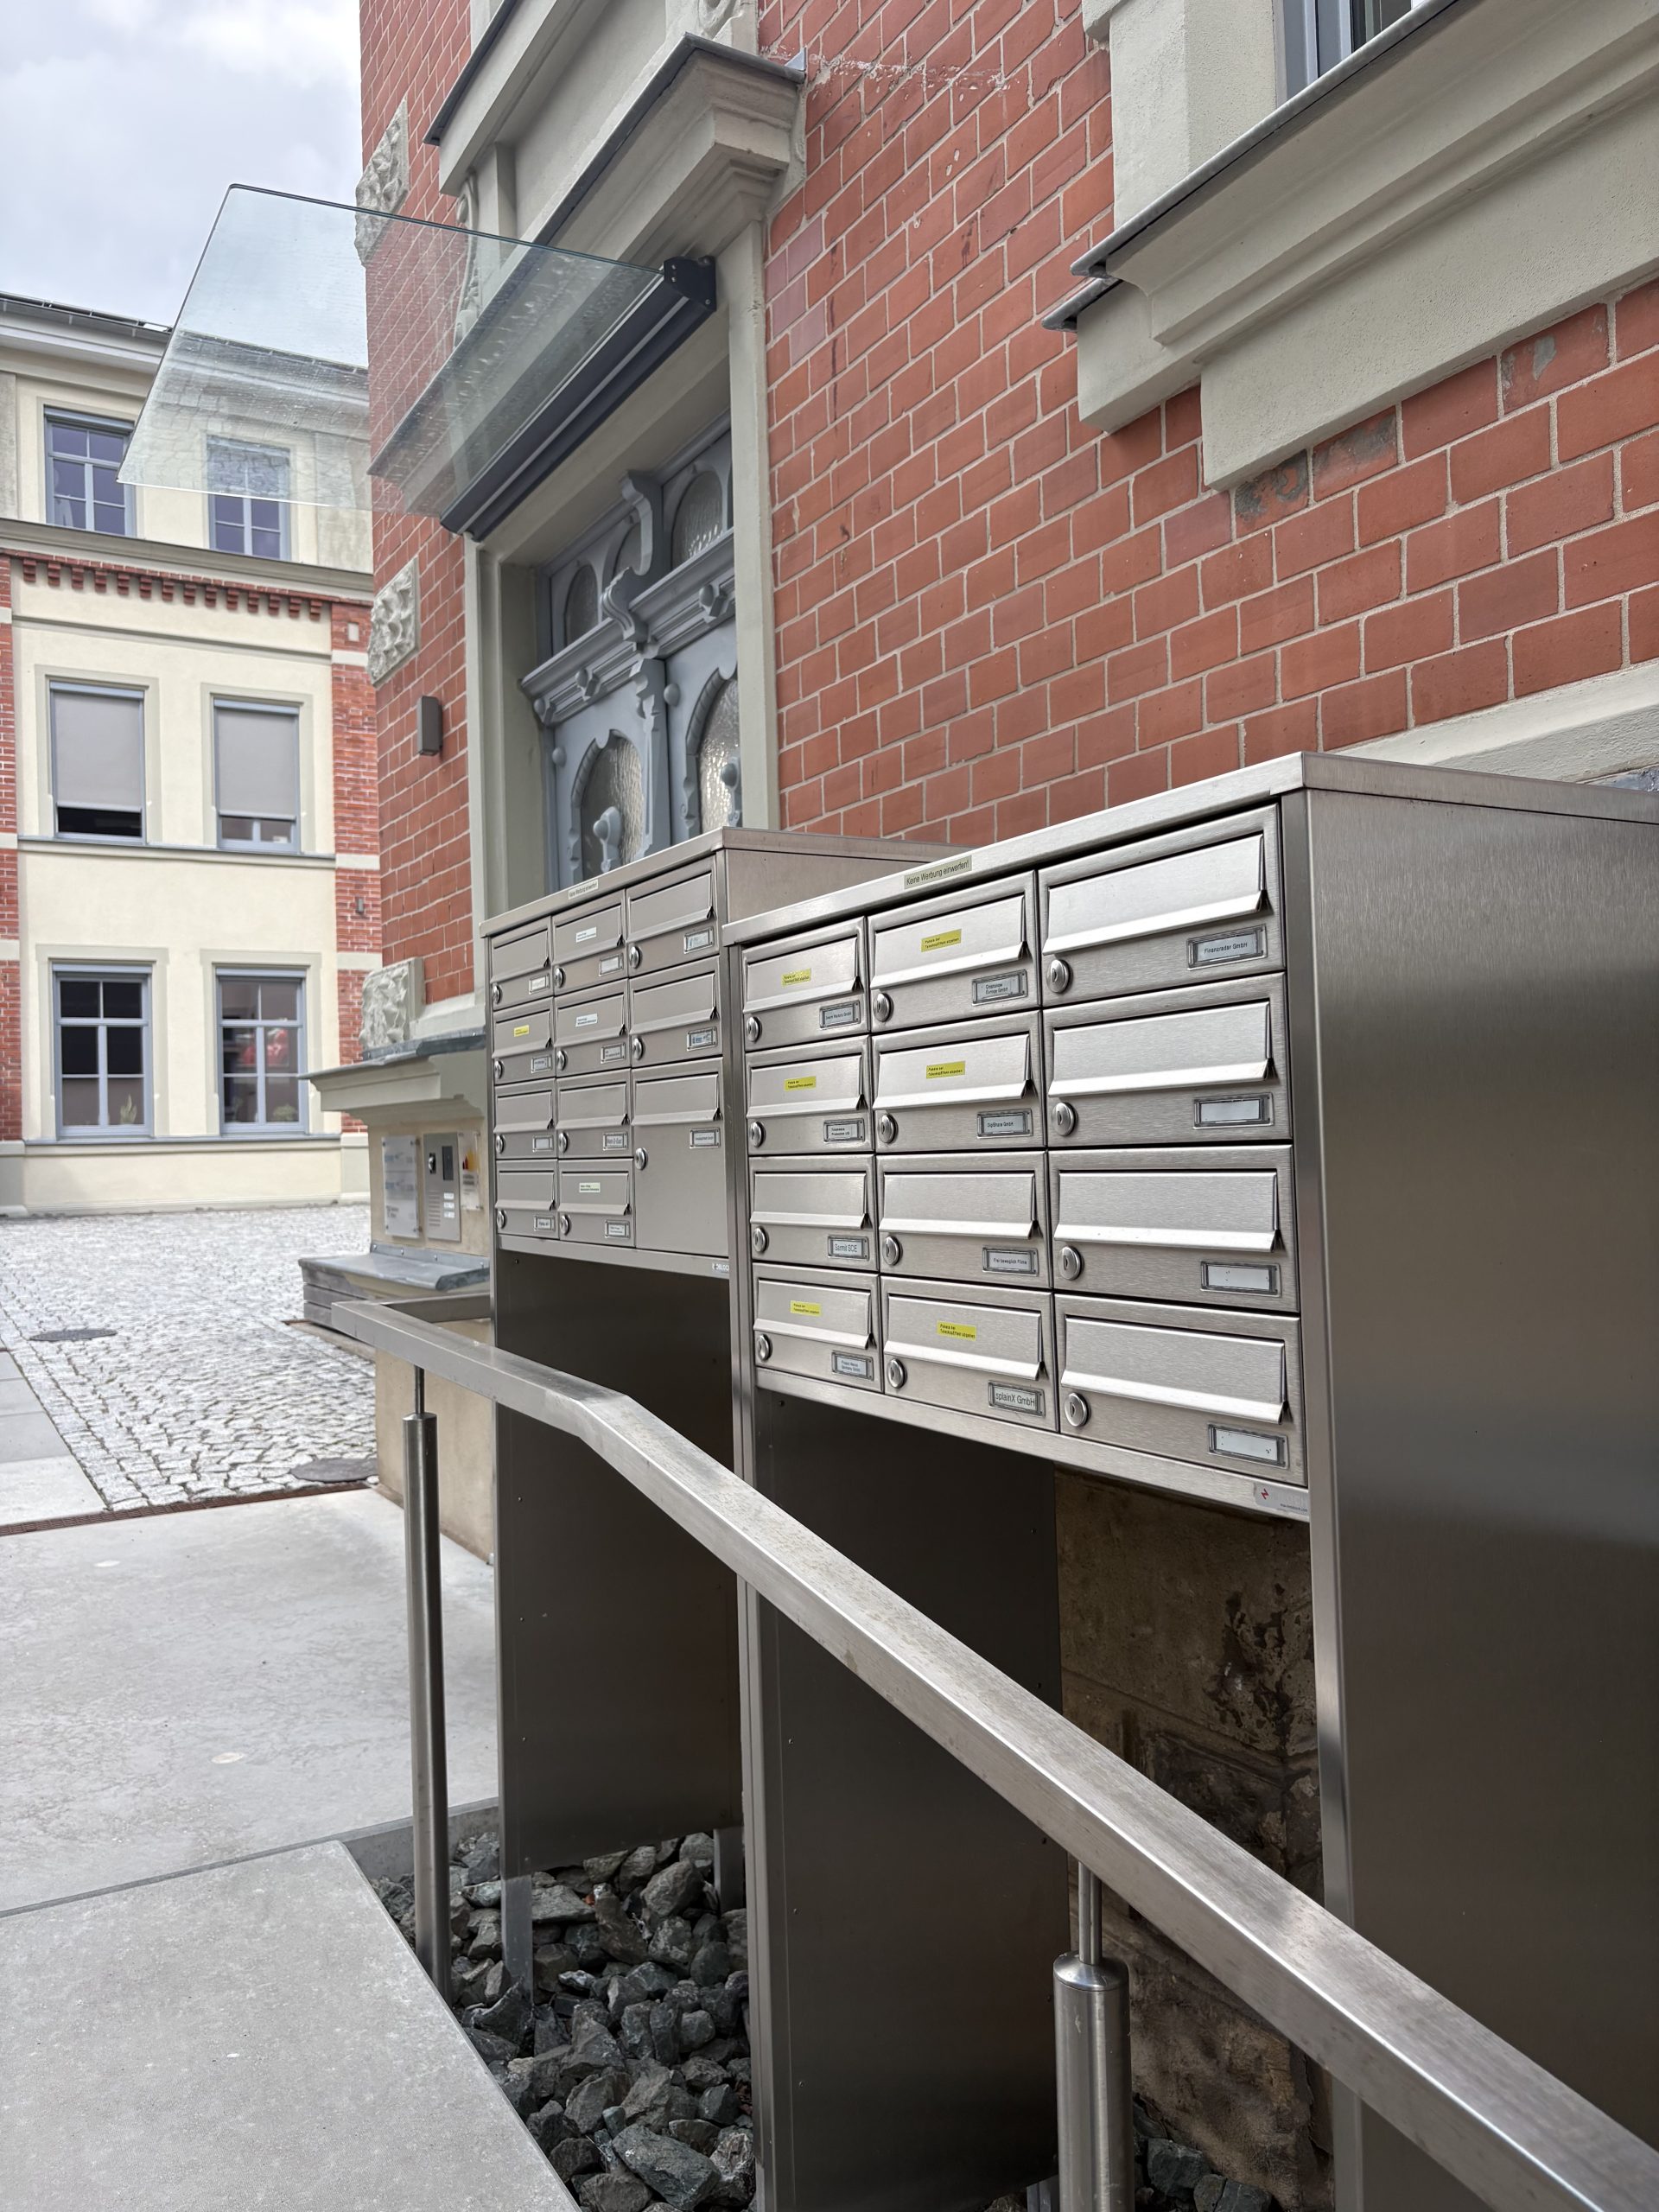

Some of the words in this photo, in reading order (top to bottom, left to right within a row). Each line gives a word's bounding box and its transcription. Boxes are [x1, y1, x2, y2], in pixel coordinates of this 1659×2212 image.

[906, 875, 920, 886] Keine
[920, 869, 943, 880] Werbung
[1204, 945, 1231, 955] Finanzradar
[1231, 942, 1248, 950] GmbH
[995, 1392, 1016, 1403] splainX
[1016, 1395, 1035, 1407] GmbH
